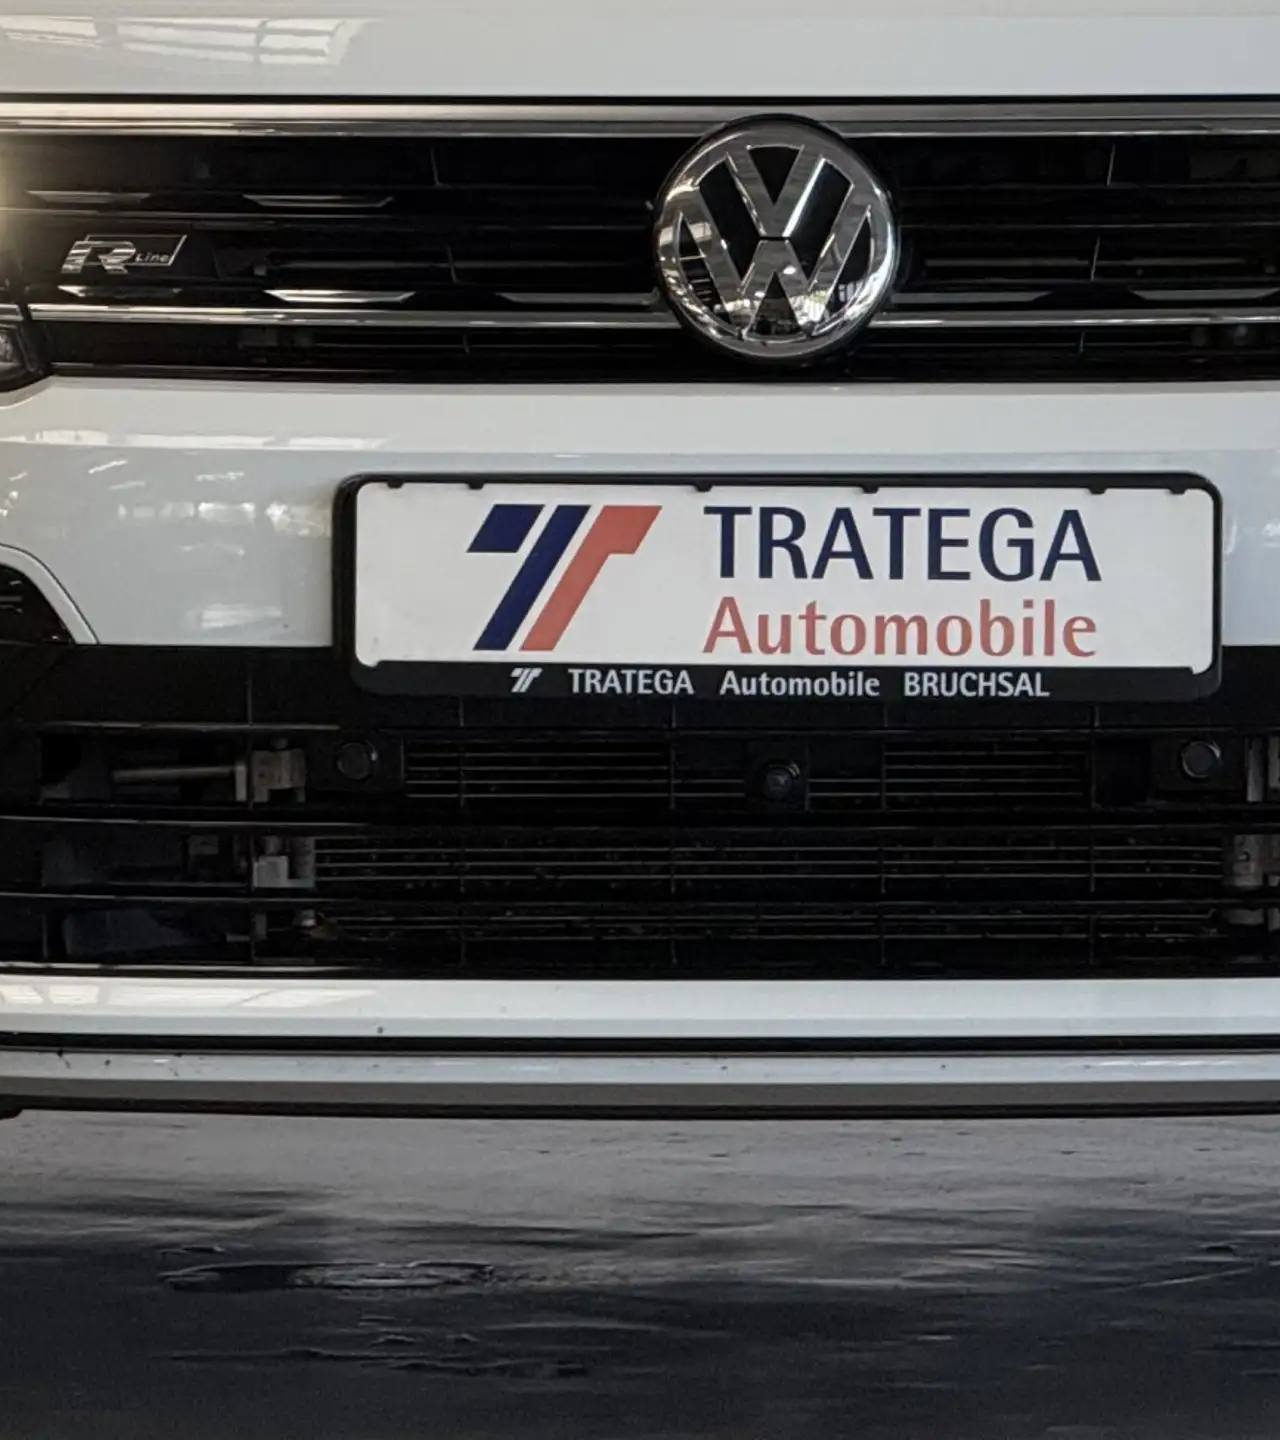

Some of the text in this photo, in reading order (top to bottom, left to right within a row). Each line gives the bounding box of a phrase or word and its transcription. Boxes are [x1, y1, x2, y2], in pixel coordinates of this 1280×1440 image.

[658, 126, 894, 356] VW
[703, 505, 1102, 582] TRATEGA
[703, 595, 1098, 658] Automobile
[567, 667, 1051, 698] TRATEGA Automobile BRUCHSAL
